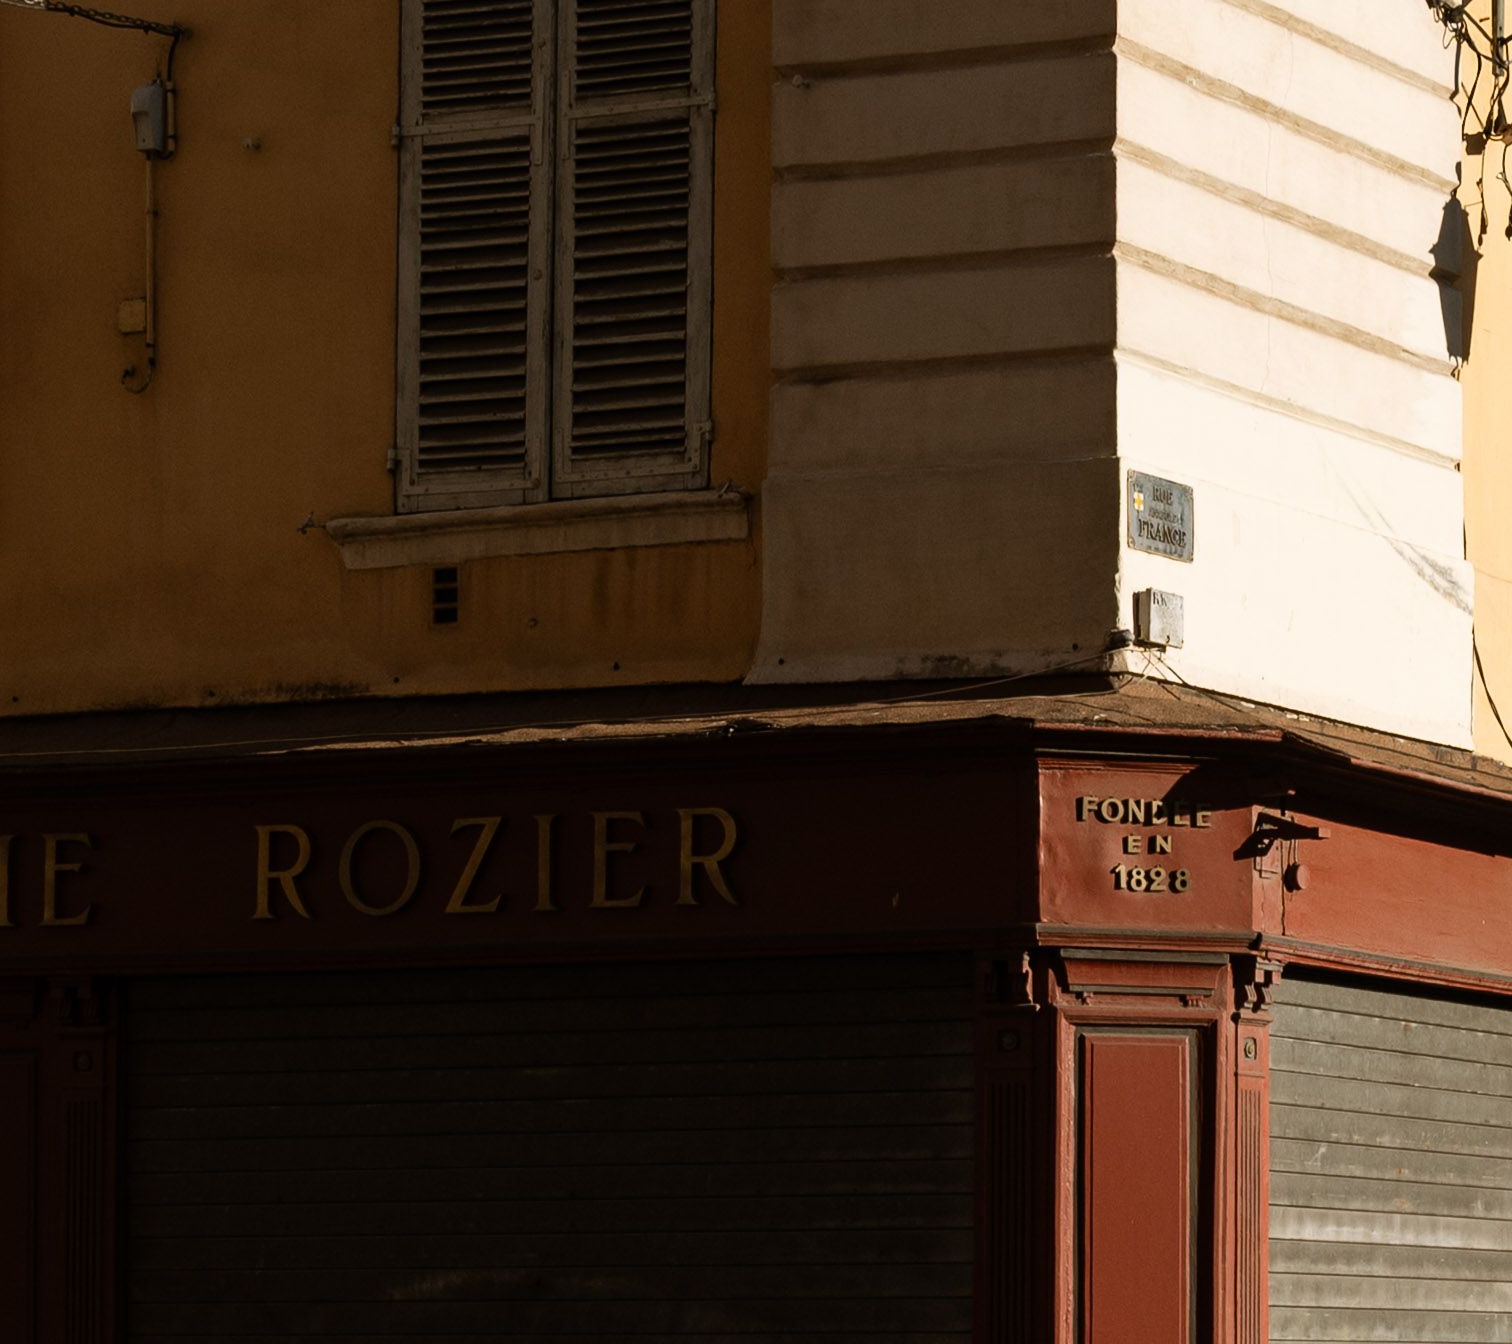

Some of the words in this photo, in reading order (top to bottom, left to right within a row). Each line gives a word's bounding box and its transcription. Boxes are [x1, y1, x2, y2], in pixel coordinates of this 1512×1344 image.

[1152, 486, 1174, 506] RUE
[1137, 519, 1187, 548] FRANCE
[1126, 833, 1173, 855] EN
[251, 806, 741, 920] ROZIER
[1115, 863, 1190, 892] 1828
